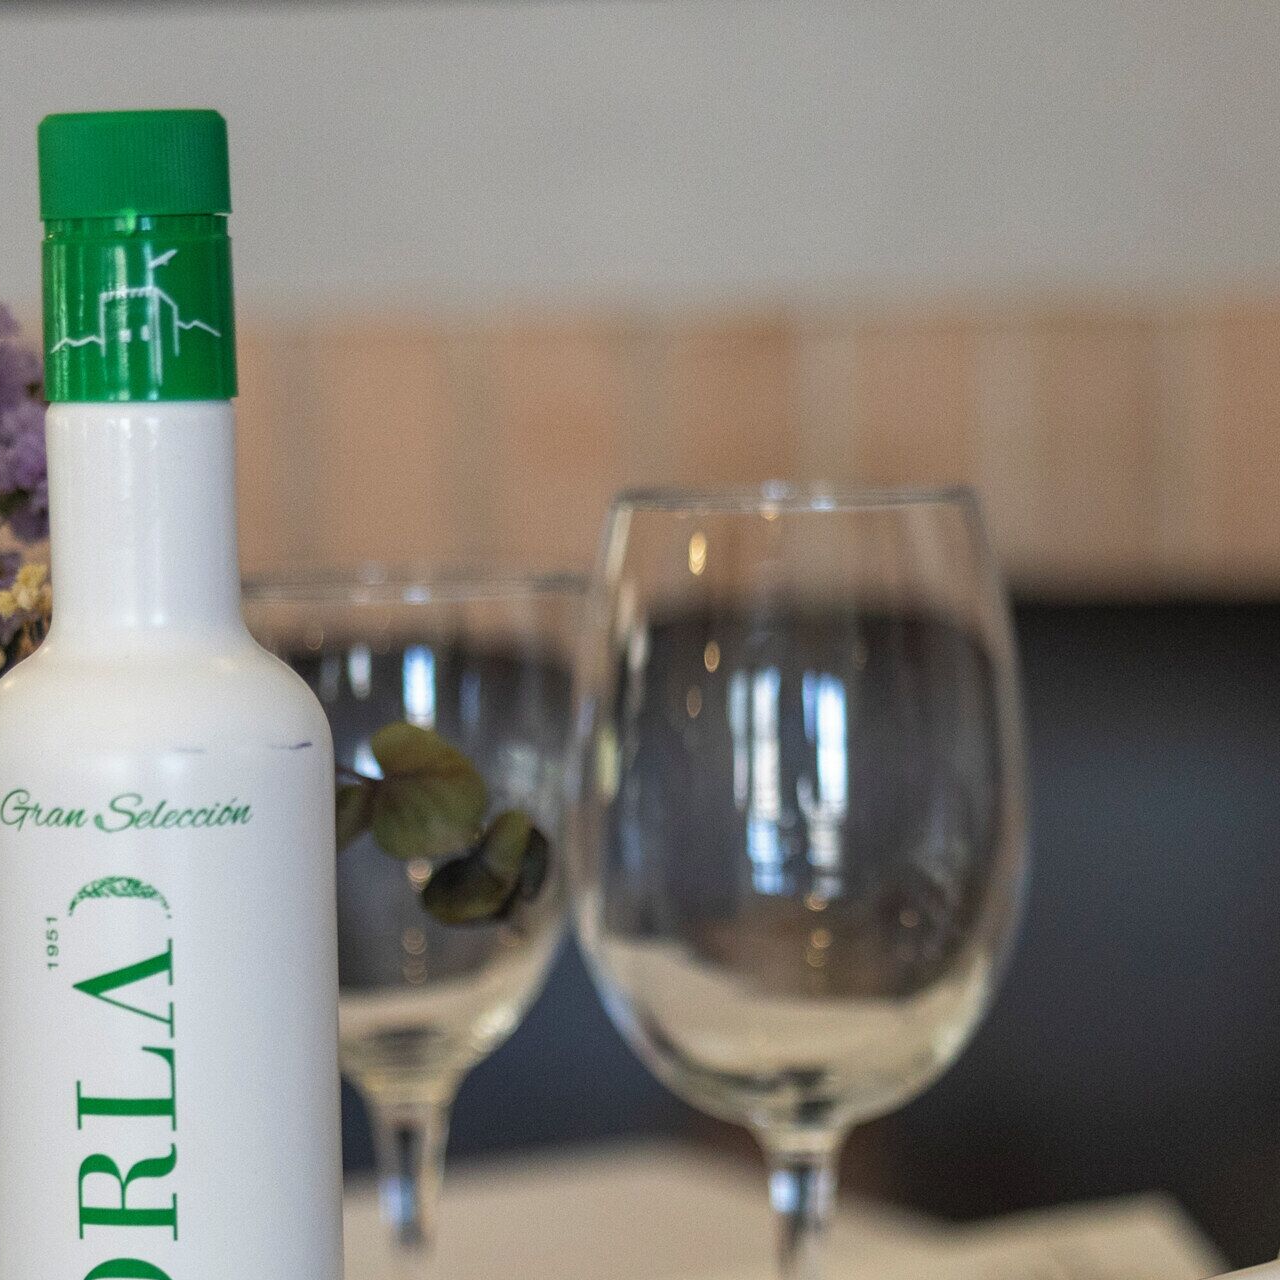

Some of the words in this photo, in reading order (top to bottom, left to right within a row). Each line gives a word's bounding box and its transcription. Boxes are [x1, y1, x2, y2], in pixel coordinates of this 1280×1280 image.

[0, 788, 87, 830] Gran
[93, 792, 254, 834] Selección
[45, 915, 60, 971] 1951
